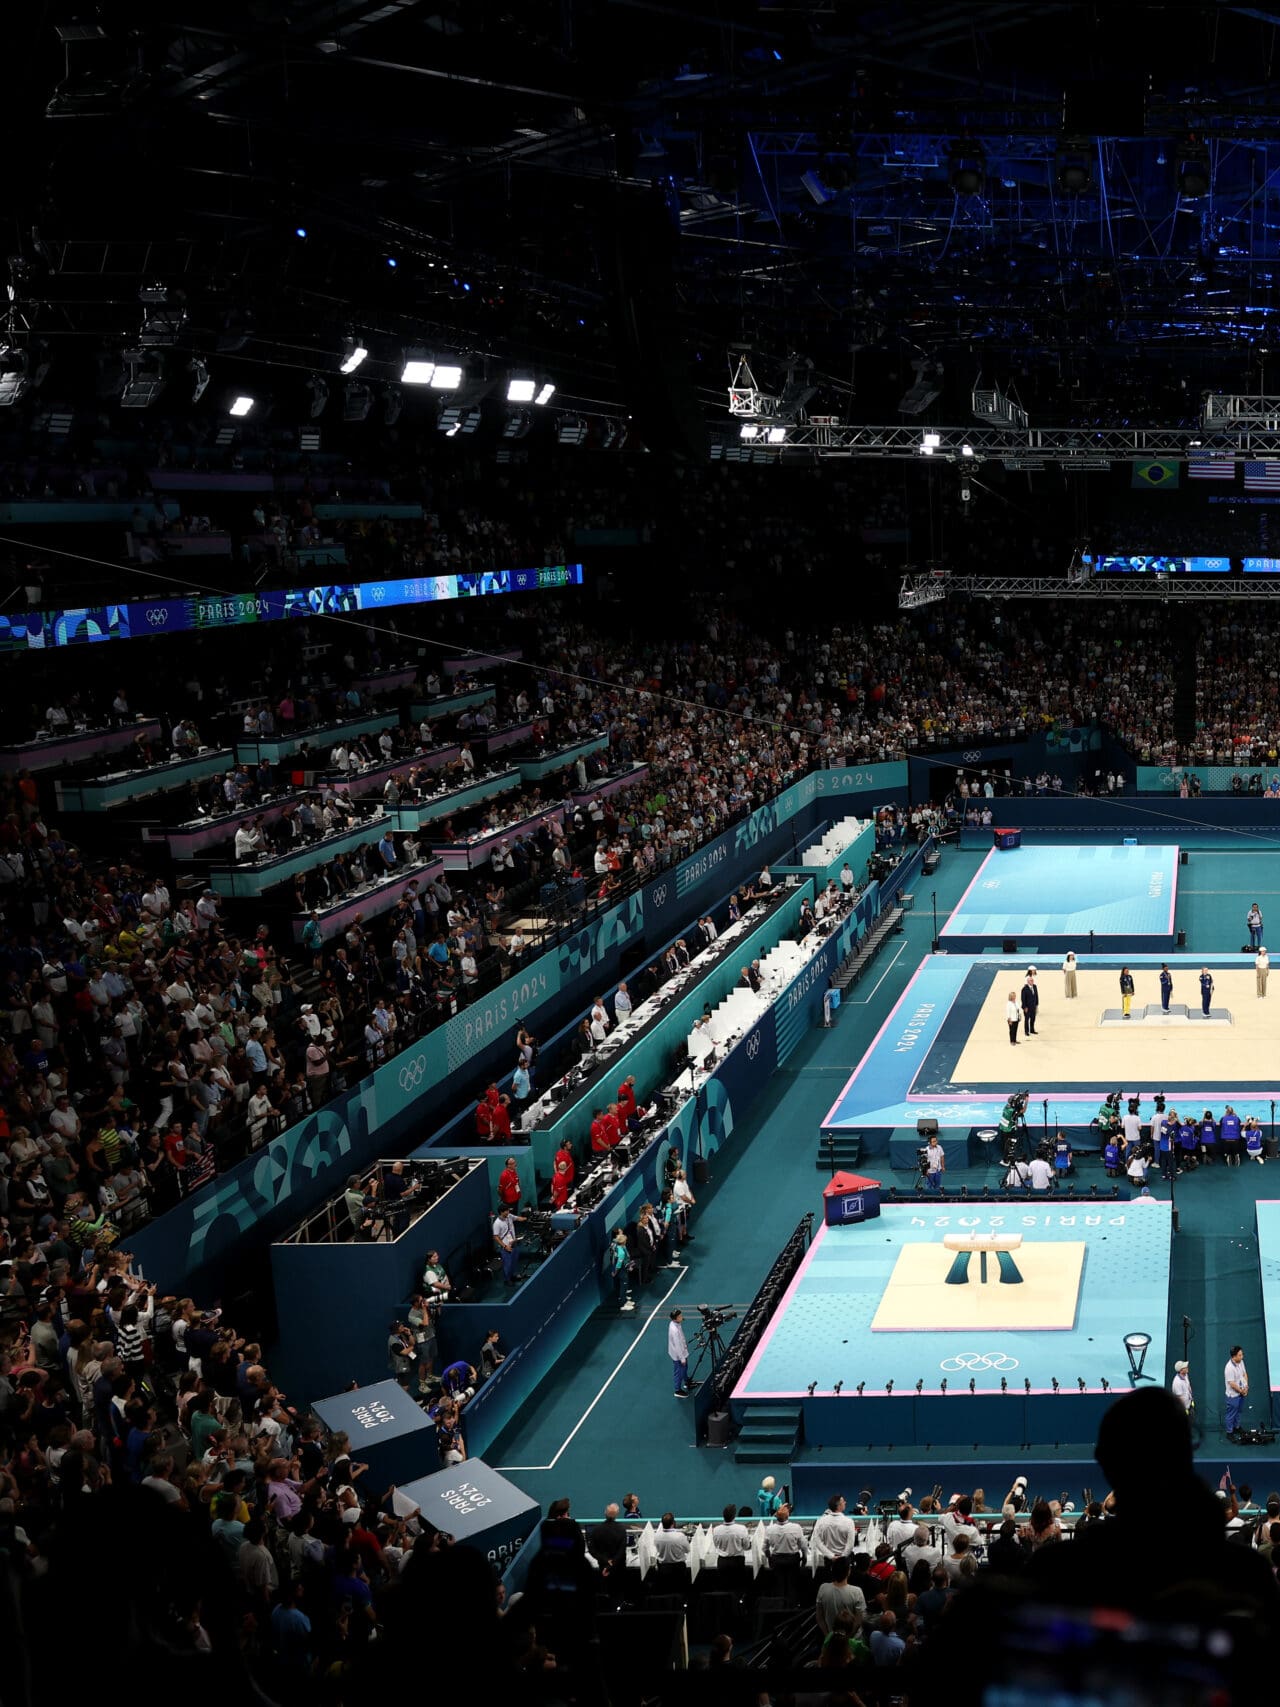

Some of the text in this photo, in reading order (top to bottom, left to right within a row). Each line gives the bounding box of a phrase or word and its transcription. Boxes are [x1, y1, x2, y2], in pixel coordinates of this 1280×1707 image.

[239, 600, 270, 617] 2024
[831, 772, 873, 790] 2024
[708, 843, 727, 869] 2024
[810, 953, 828, 985] 2024
[511, 973, 548, 1012] 2024
[893, 1028, 922, 1052] 2024
[911, 1215, 1005, 1227] 2024
[369, 1401, 396, 1423] 2024
[458, 1482, 492, 1508] 2024
